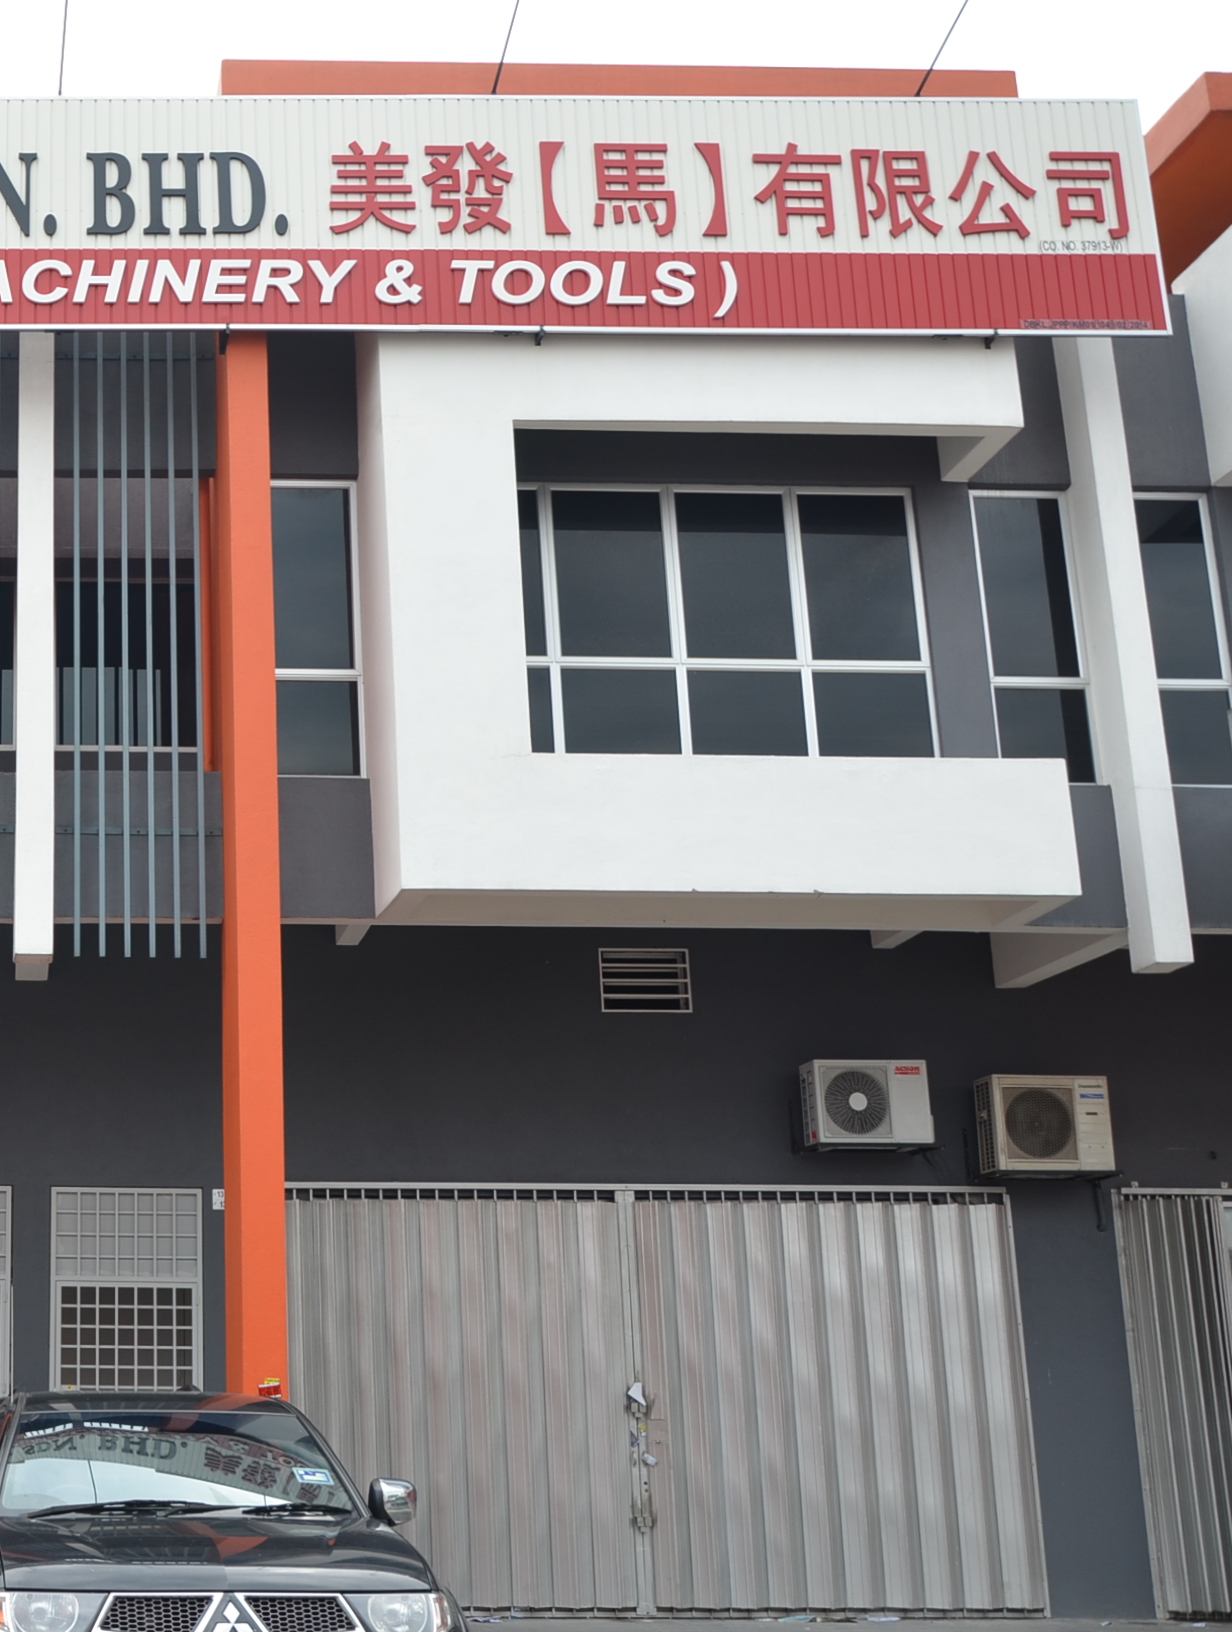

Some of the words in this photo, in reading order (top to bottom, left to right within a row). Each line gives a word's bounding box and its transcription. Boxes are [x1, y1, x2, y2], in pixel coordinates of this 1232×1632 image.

[86, 151, 289, 238] BHD.
[1061, 241, 1079, 252] NO.
[375, 259, 422, 304] &
